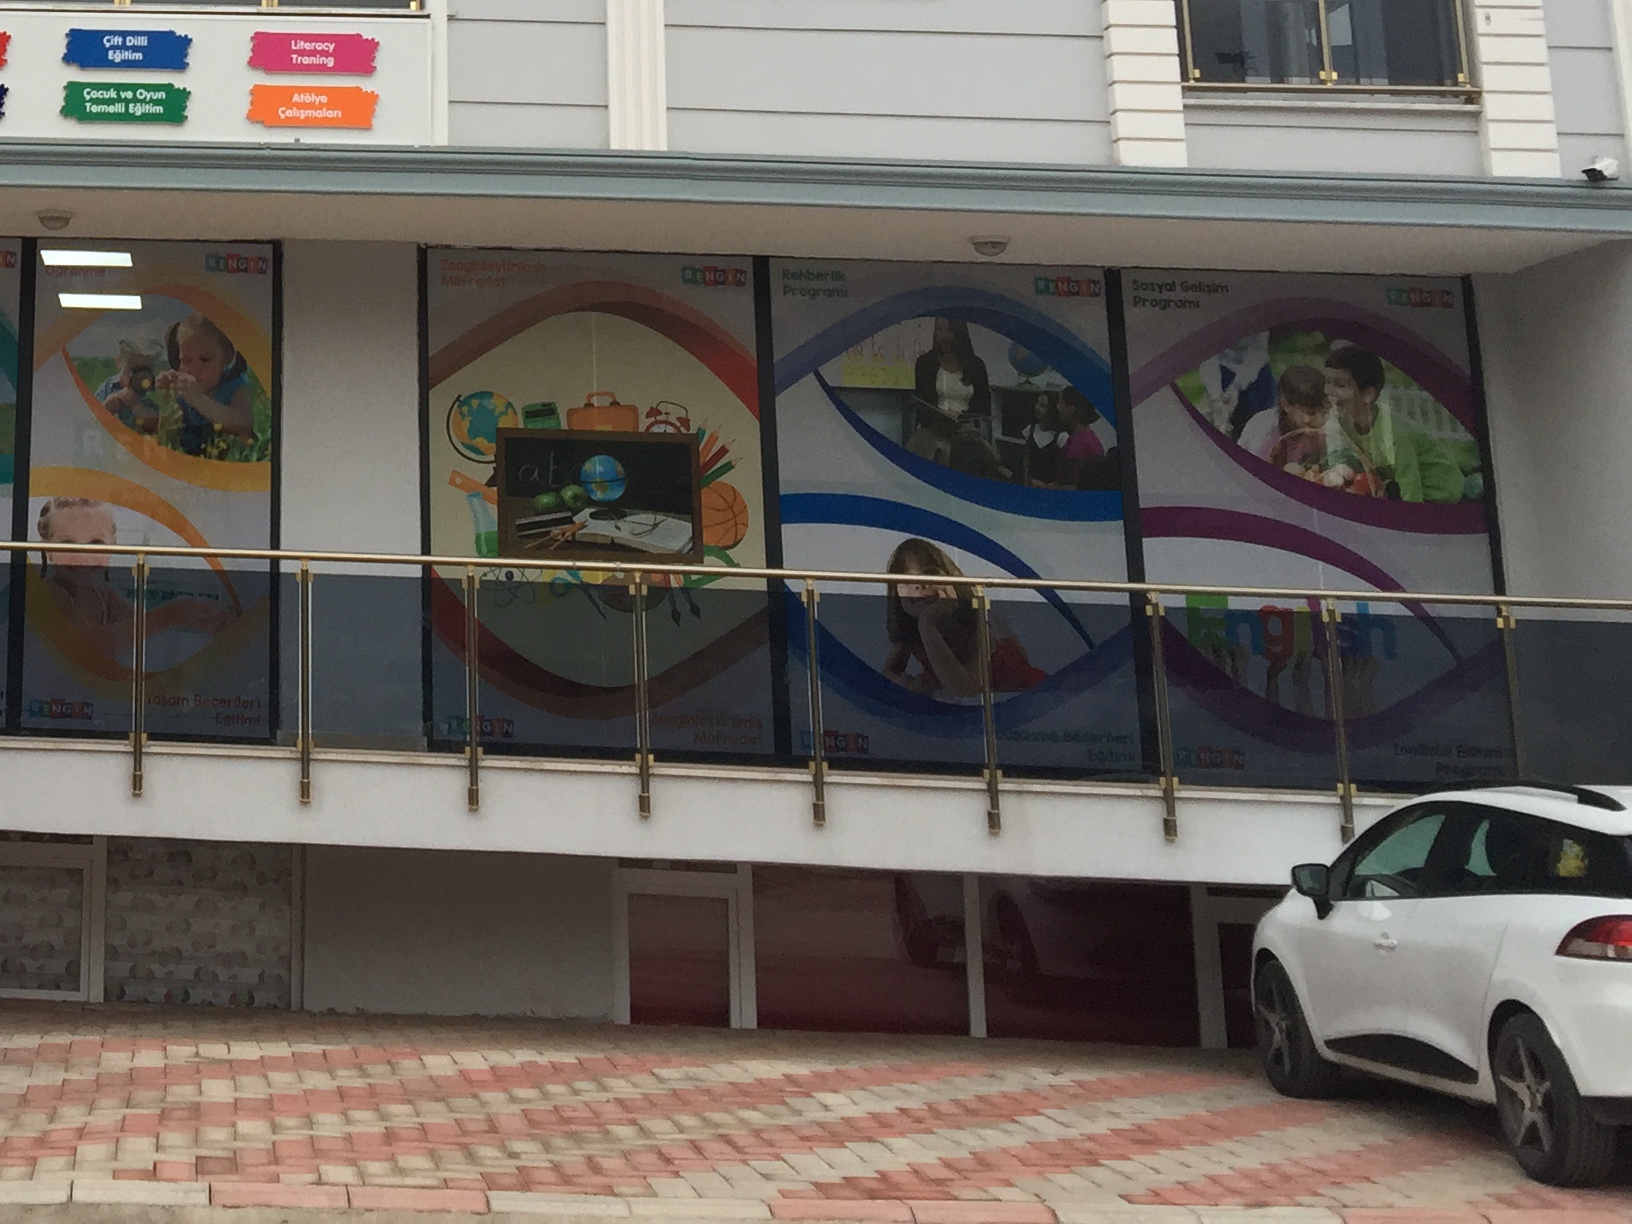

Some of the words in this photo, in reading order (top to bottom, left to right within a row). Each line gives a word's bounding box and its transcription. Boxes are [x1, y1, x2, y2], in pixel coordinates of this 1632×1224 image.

[102, 34, 124, 48] Çift
[125, 35, 149, 47] Dilli
[290, 39, 335, 52] Literacy
[107, 49, 144, 63] Eğitim
[83, 87, 118, 101] Çocuk
[119, 90, 134, 100] ve
[135, 89, 167, 102] Oyun
[291, 92, 328, 105] Atölye
[84, 101, 126, 114] Temelli
[128, 102, 165, 117] Eğitim
[277, 106, 342, 120] Çalışmaları
[1131, 279, 1177, 294] Sosyal
[1179, 280, 1230, 296] Gelişim
[1132, 295, 1201, 311] Programı
